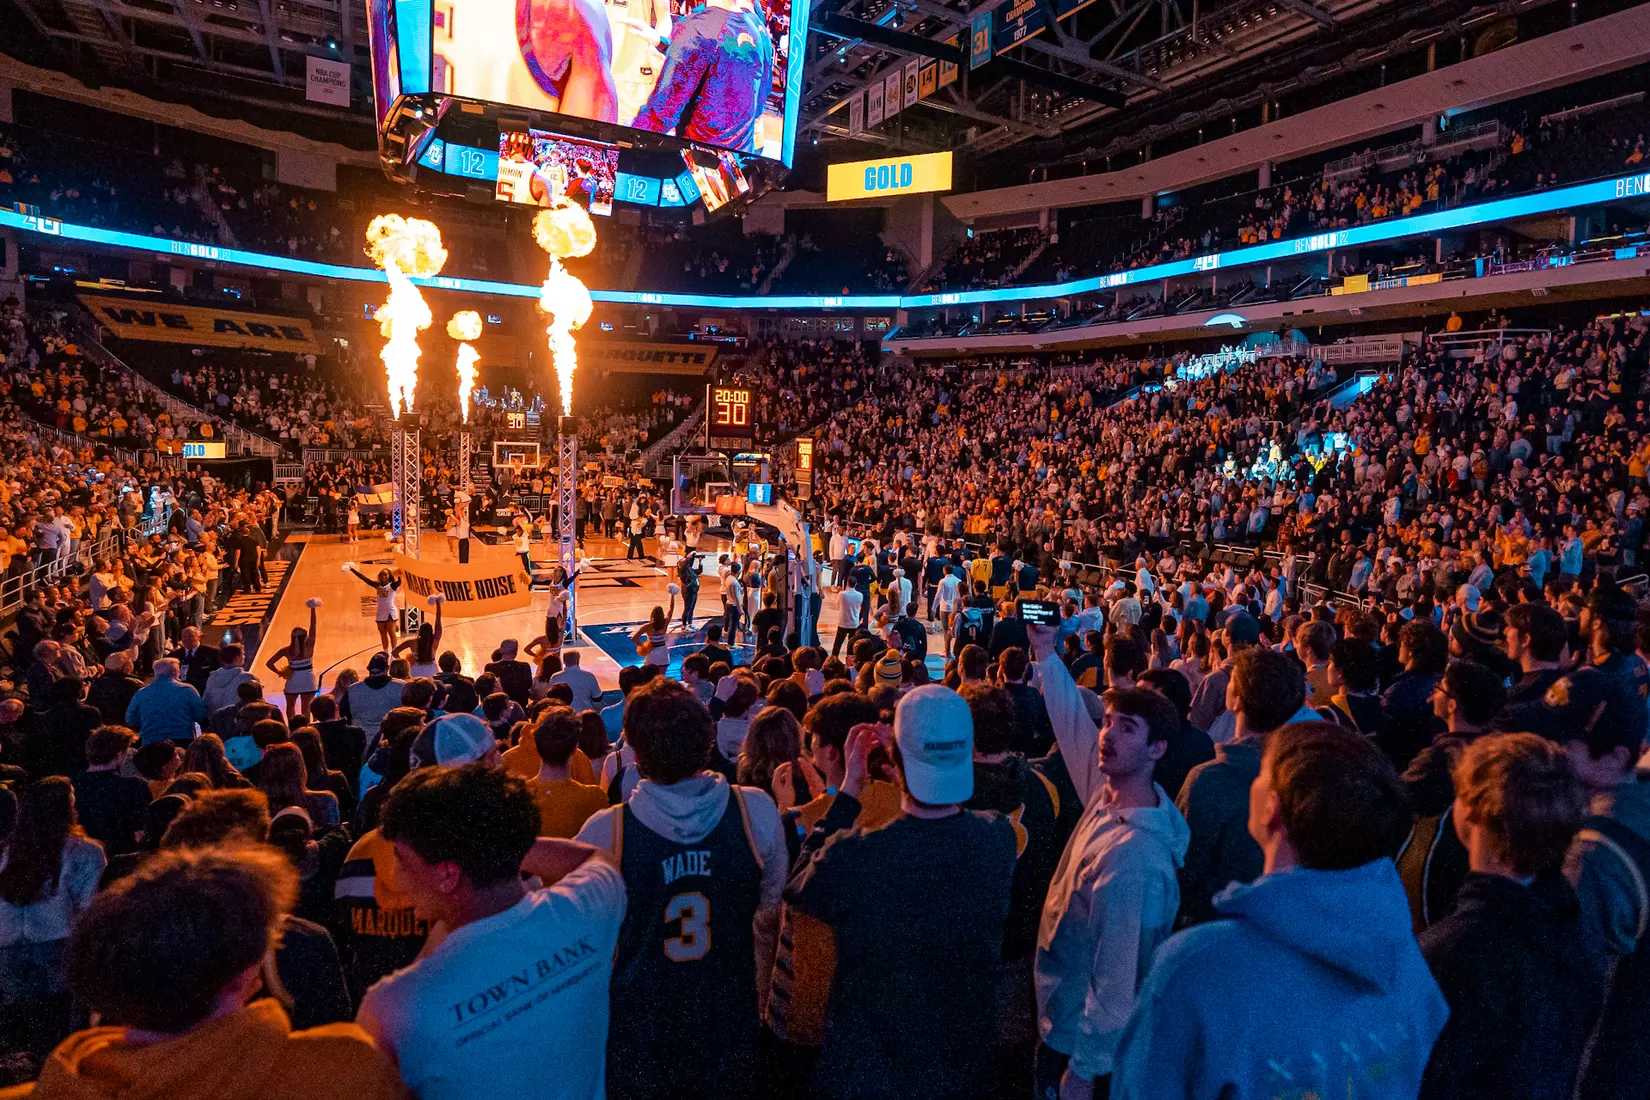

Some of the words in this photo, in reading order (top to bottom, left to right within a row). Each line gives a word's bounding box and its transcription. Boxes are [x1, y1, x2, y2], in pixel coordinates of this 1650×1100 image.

[974, 27, 989, 55] 31
[1014, 25, 1027, 41] 1977
[310, 74, 346, 87] CHAMPIONS
[315, 68, 328, 77] NBA
[922, 68, 932, 86] 14
[461, 150, 485, 175] 12
[865, 163, 913, 191] GOLD
[627, 178, 648, 200] 12
[101, 307, 194, 330] WE
[213, 319, 311, 341] ARE
[715, 390, 749, 403] 20:00
[508, 419, 523, 428] 30
[717, 403, 746, 424] 30
[404, 570, 432, 597] MAKE
[434, 580, 474, 601] SOME
[474, 574, 517, 600] NOISE
[661, 850, 712, 885] WADE
[664, 891, 711, 962] 3
[448, 968, 529, 1022] TOWN
[535, 934, 597, 978] BANK
